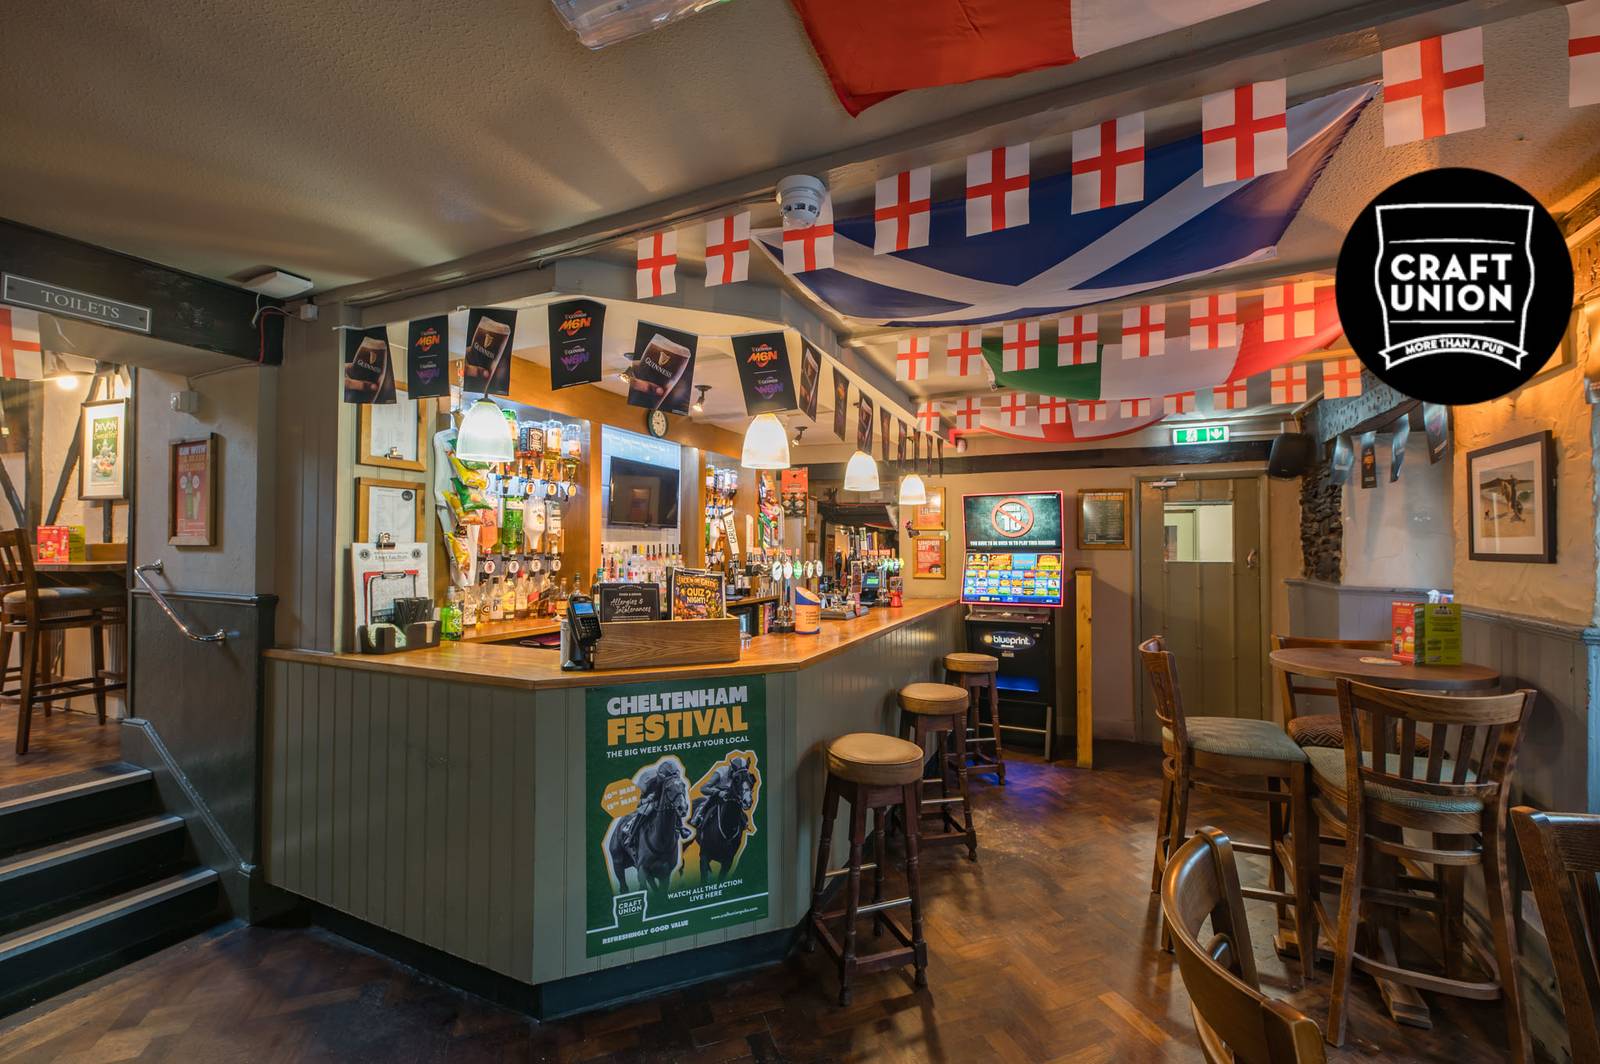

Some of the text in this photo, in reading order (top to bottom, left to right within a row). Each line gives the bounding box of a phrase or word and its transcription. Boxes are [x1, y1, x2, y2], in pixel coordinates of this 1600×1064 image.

[41, 290, 120, 318] TOILETS
[645, 356, 673, 378] GUINNESS
[687, 588, 705, 597] QUIZ
[610, 598, 638, 607] Allergies
[615, 605, 652, 614] Intolerances
[993, 635, 1030, 645] blueprint
[606, 686, 748, 716] CHELTENHAM
[607, 706, 748, 746] FESTIVAL
[606, 750, 623, 758] THE
[624, 748, 638, 757] BIG
[639, 745, 662, 754] WEEK
[663, 742, 691, 751] STARTS
[702, 738, 724, 747] YOUR
[725, 735, 750, 744] LOCAL
[668, 878, 743, 899] WATCH ALL THE ACTION
[689, 890, 722, 902] LIVE HERE
[618, 905, 642, 915] UNION
[619, 899, 642, 910] CRAFT
[602, 920, 689, 944] REFRESHINGLY GOOD VALUE
